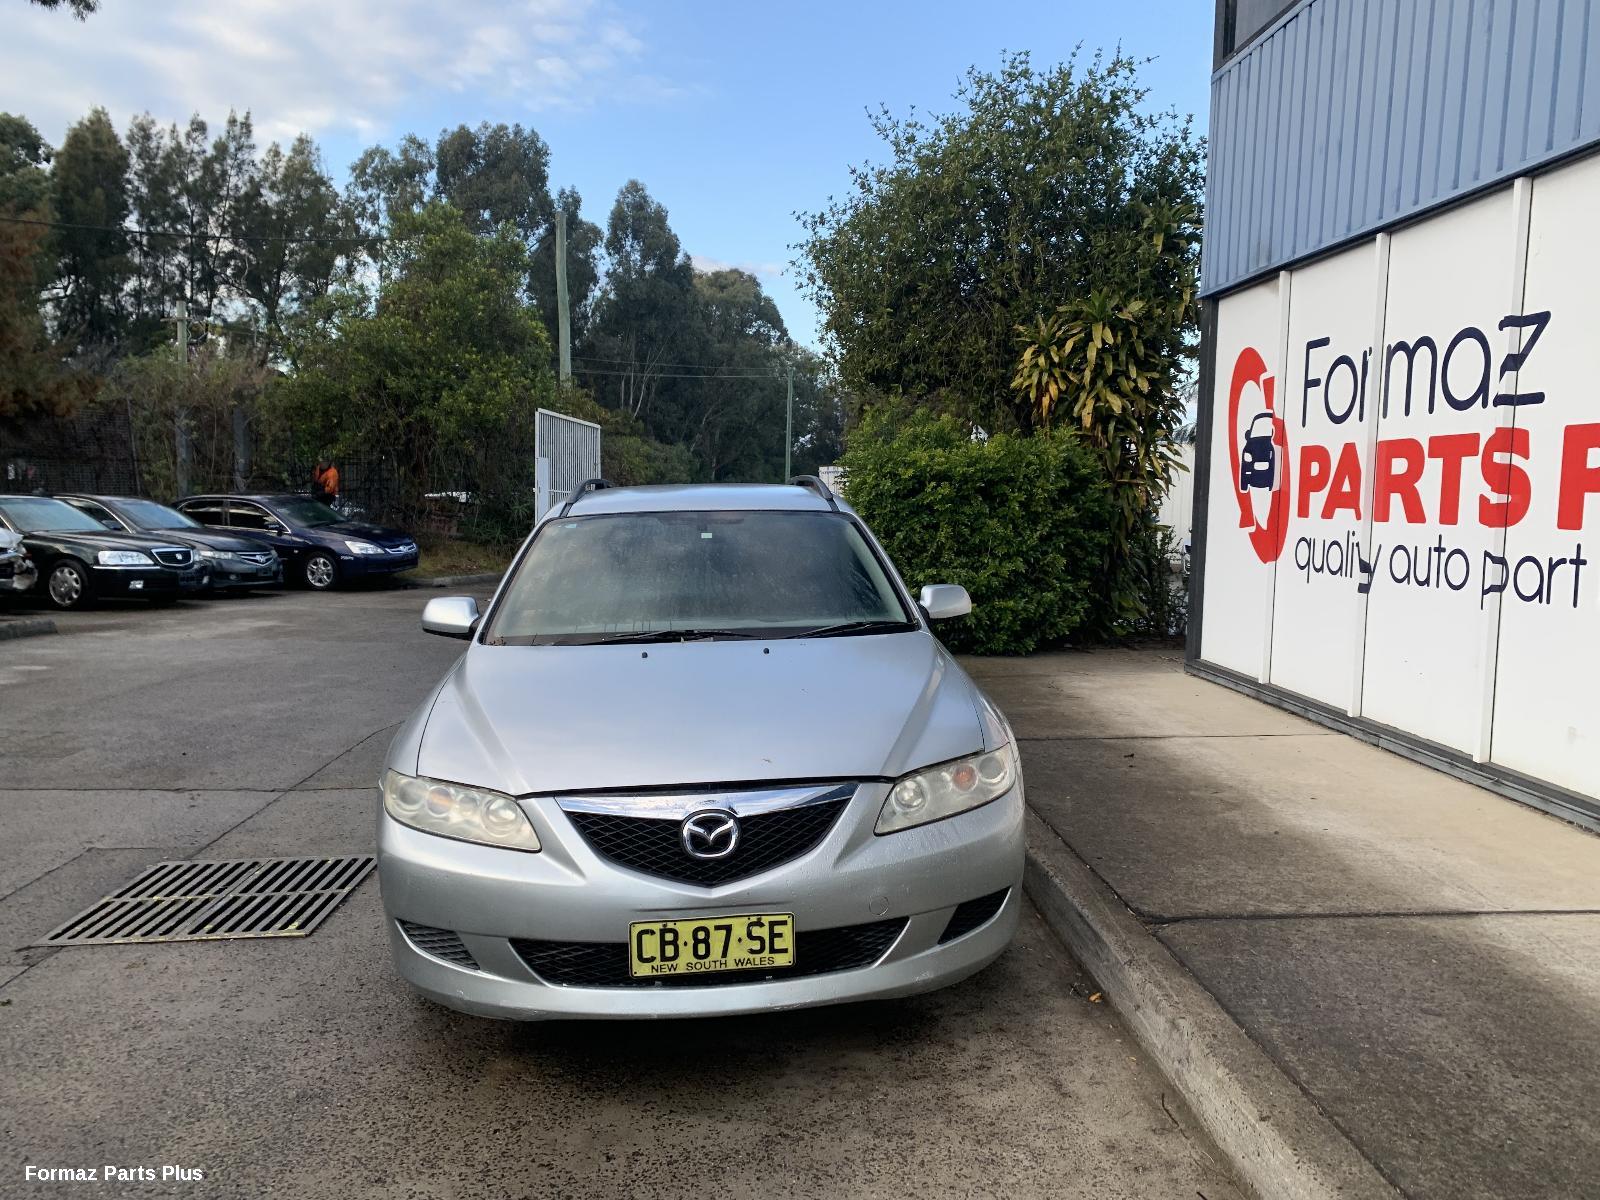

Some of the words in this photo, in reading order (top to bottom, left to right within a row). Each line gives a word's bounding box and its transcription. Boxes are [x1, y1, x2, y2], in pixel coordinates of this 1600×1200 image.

[1302, 311, 1551, 427] Formaz
[1297, 428, 1532, 528] PARTS
[1389, 534, 1470, 591] auto
[1481, 543, 1588, 610] part
[650, 963, 678, 973] NEW
[685, 959, 728, 971] SOUTH
[734, 956, 775, 967] WALES
